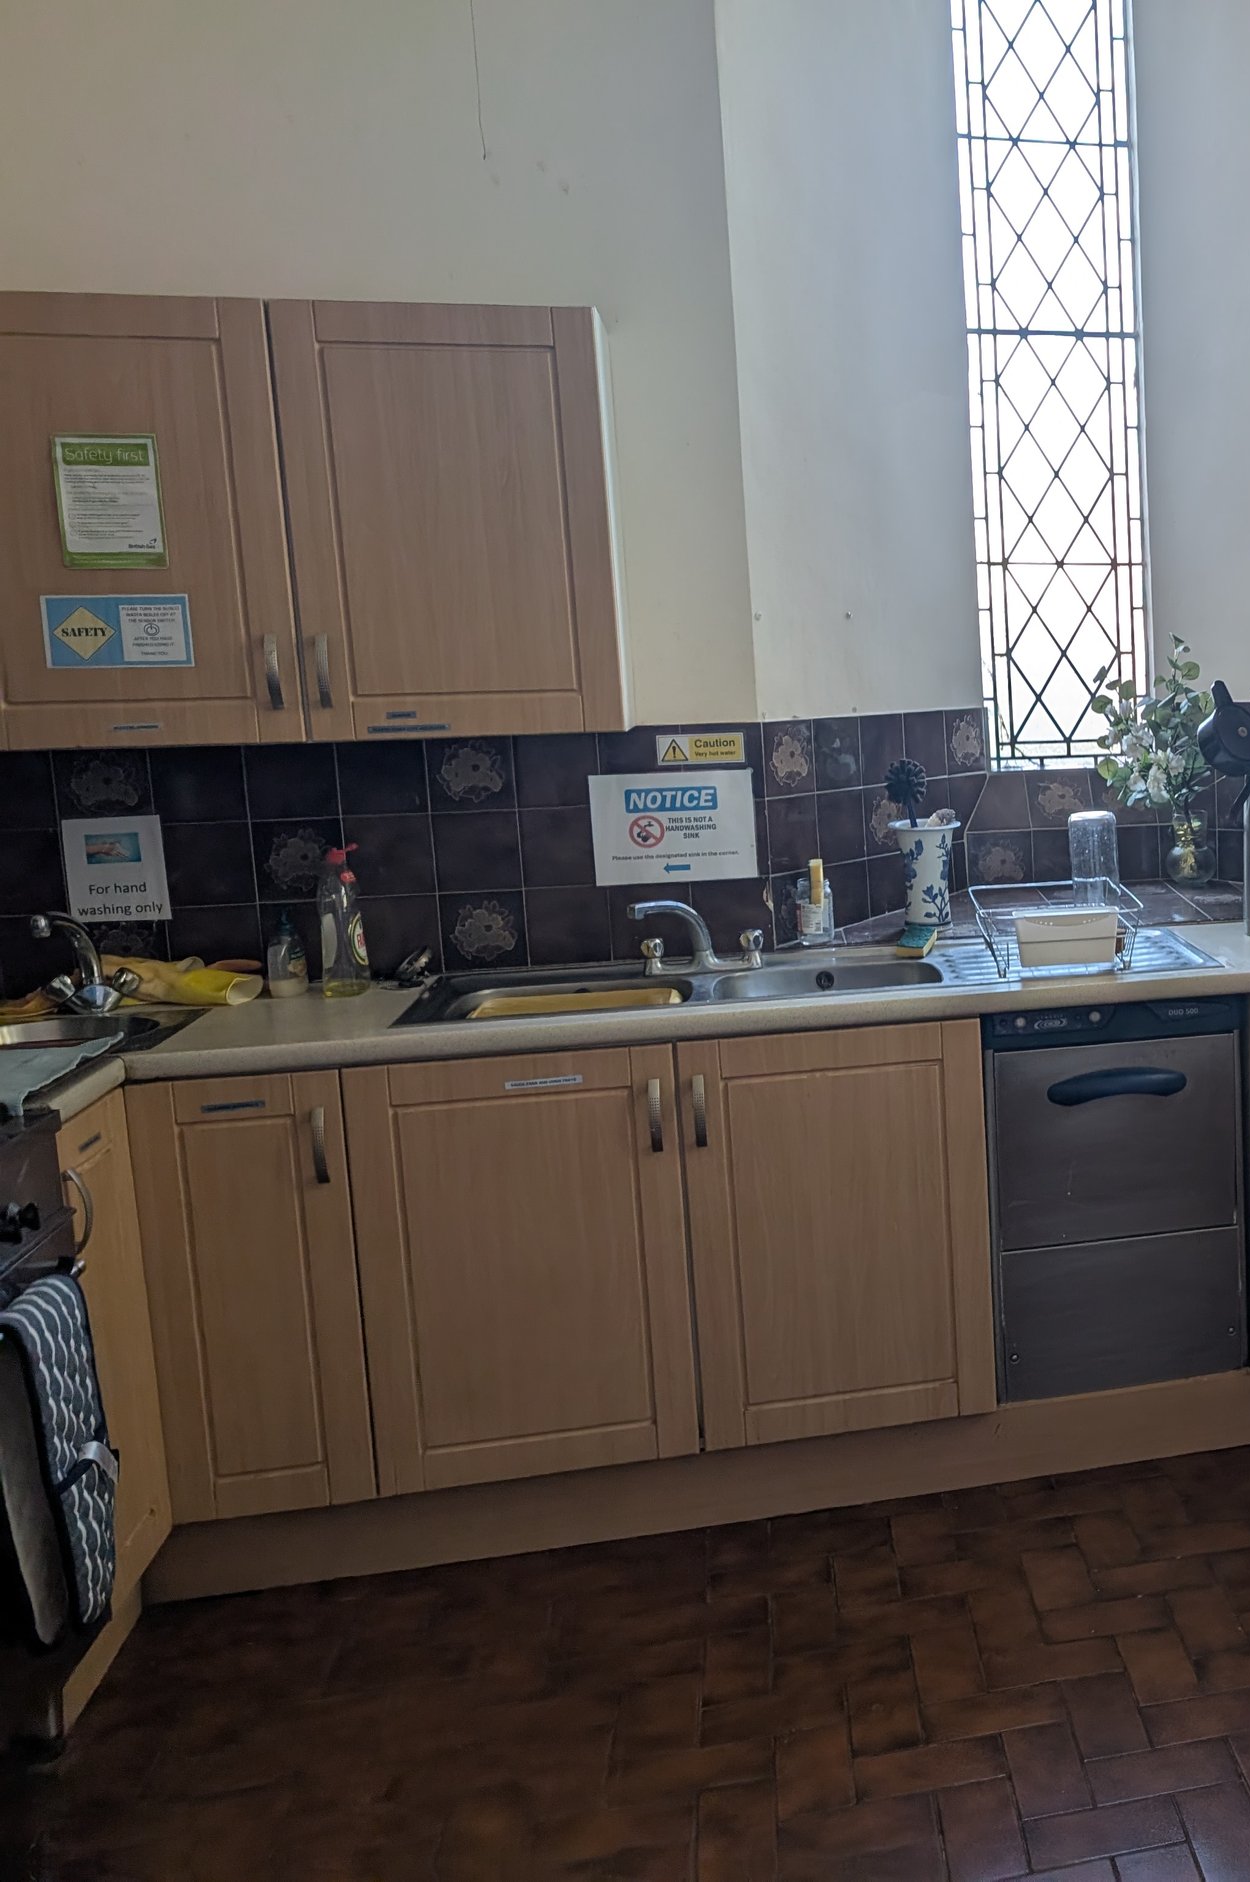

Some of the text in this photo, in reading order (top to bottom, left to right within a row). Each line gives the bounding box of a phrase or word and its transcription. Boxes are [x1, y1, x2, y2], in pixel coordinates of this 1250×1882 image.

[64, 447, 143, 464] Safety first
[61, 627, 107, 637] SAFETY
[694, 738, 736, 749] Caution
[629, 788, 715, 810] NOTICE
[665, 824, 717, 832] HANDWASHING
[655, 852, 687, 860] designated
[88, 881, 147, 895] For hand
[77, 901, 163, 916] washing only
[1185, 1007, 1199, 1015] 500
